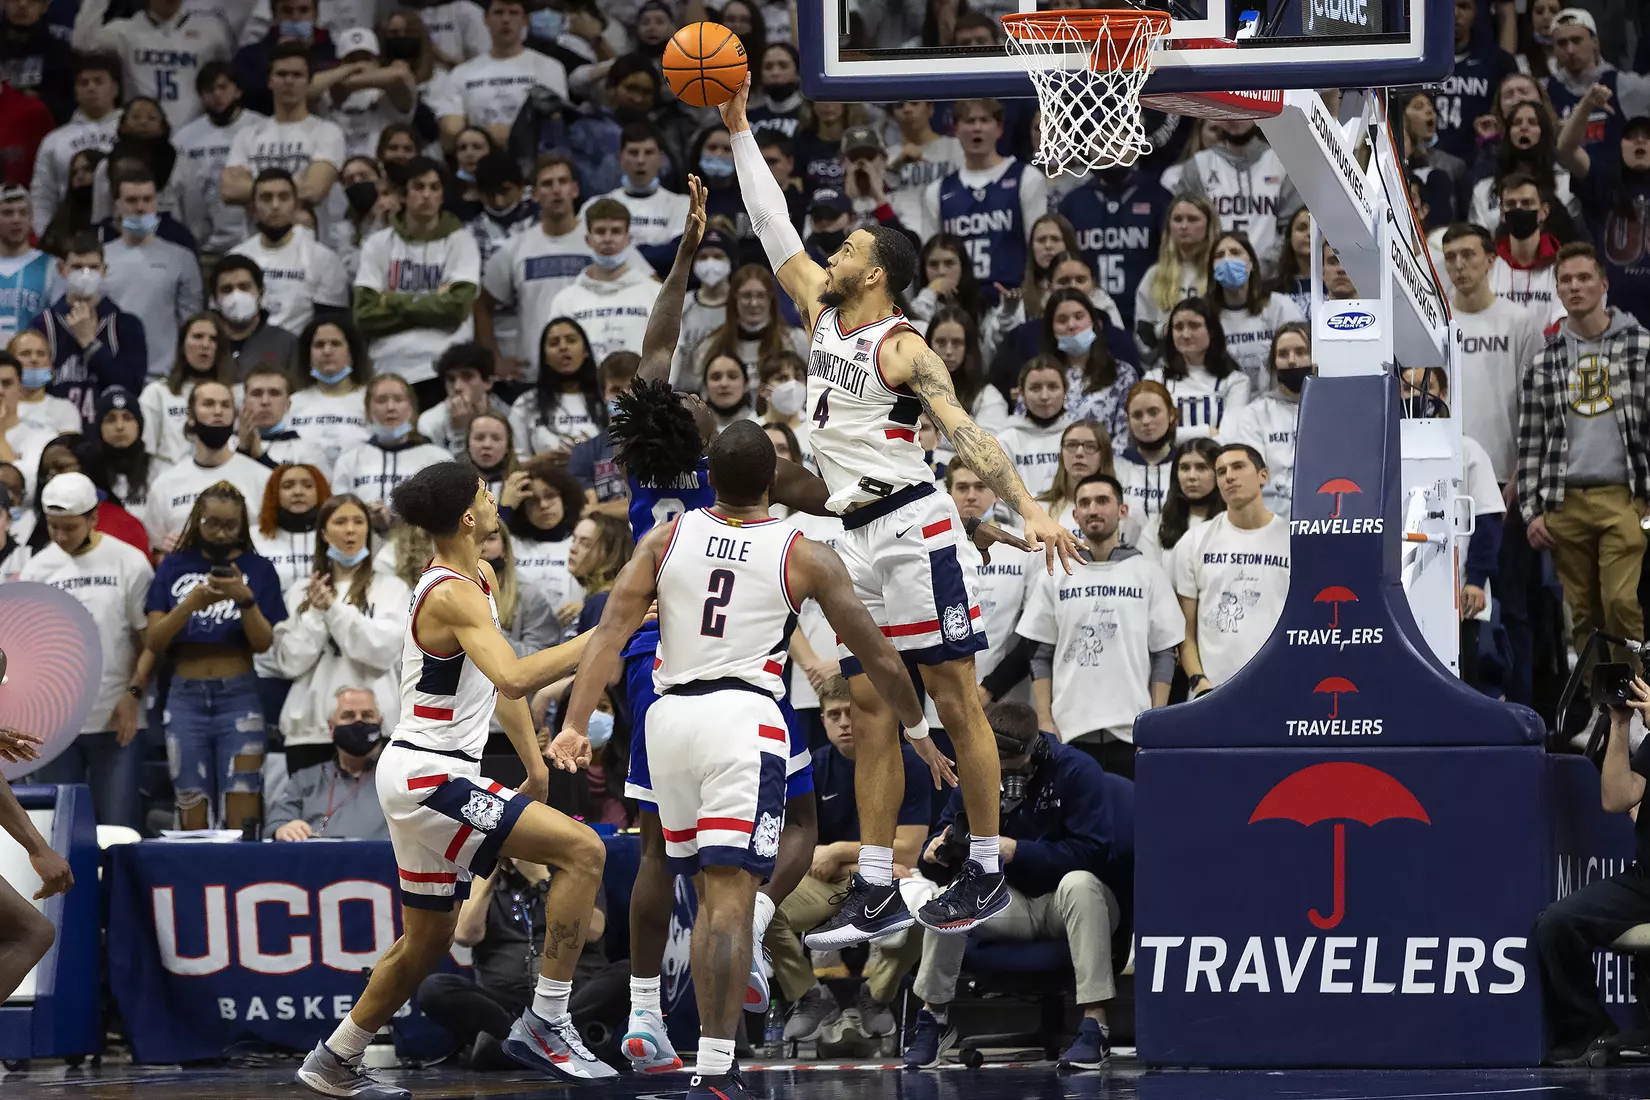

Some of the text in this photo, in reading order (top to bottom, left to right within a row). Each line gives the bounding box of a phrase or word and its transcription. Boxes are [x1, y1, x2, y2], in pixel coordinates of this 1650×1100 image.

[154, 69, 179, 100] 15
[1310, 100, 1373, 220] UCONNHUSKIES.COM
[1213, 195, 1279, 216] CONN
[1076, 226, 1149, 251] UCONN
[1098, 254, 1126, 295] 15
[1391, 237, 1438, 331] CONNHUSKIES
[1225, 332, 1255, 345] SETON
[1462, 337, 1509, 354] ONN
[807, 350, 869, 398] CONNECTICUT
[812, 387, 834, 429] 4
[1268, 432, 1289, 443] BEAT
[1289, 518, 1384, 536] TRAVELERS
[706, 536, 752, 562] COLE
[1203, 552, 1290, 569] BEAT SETON HALL
[94, 576, 119, 588] HALL
[998, 564, 1023, 576] HALL
[700, 568, 736, 639] 2
[1059, 585, 1144, 601] BEAT SETON HALL
[1286, 719, 1384, 736] TRAVELERS
[152, 879, 473, 976] UCO
[1140, 936, 1528, 994] TRAVELERS
